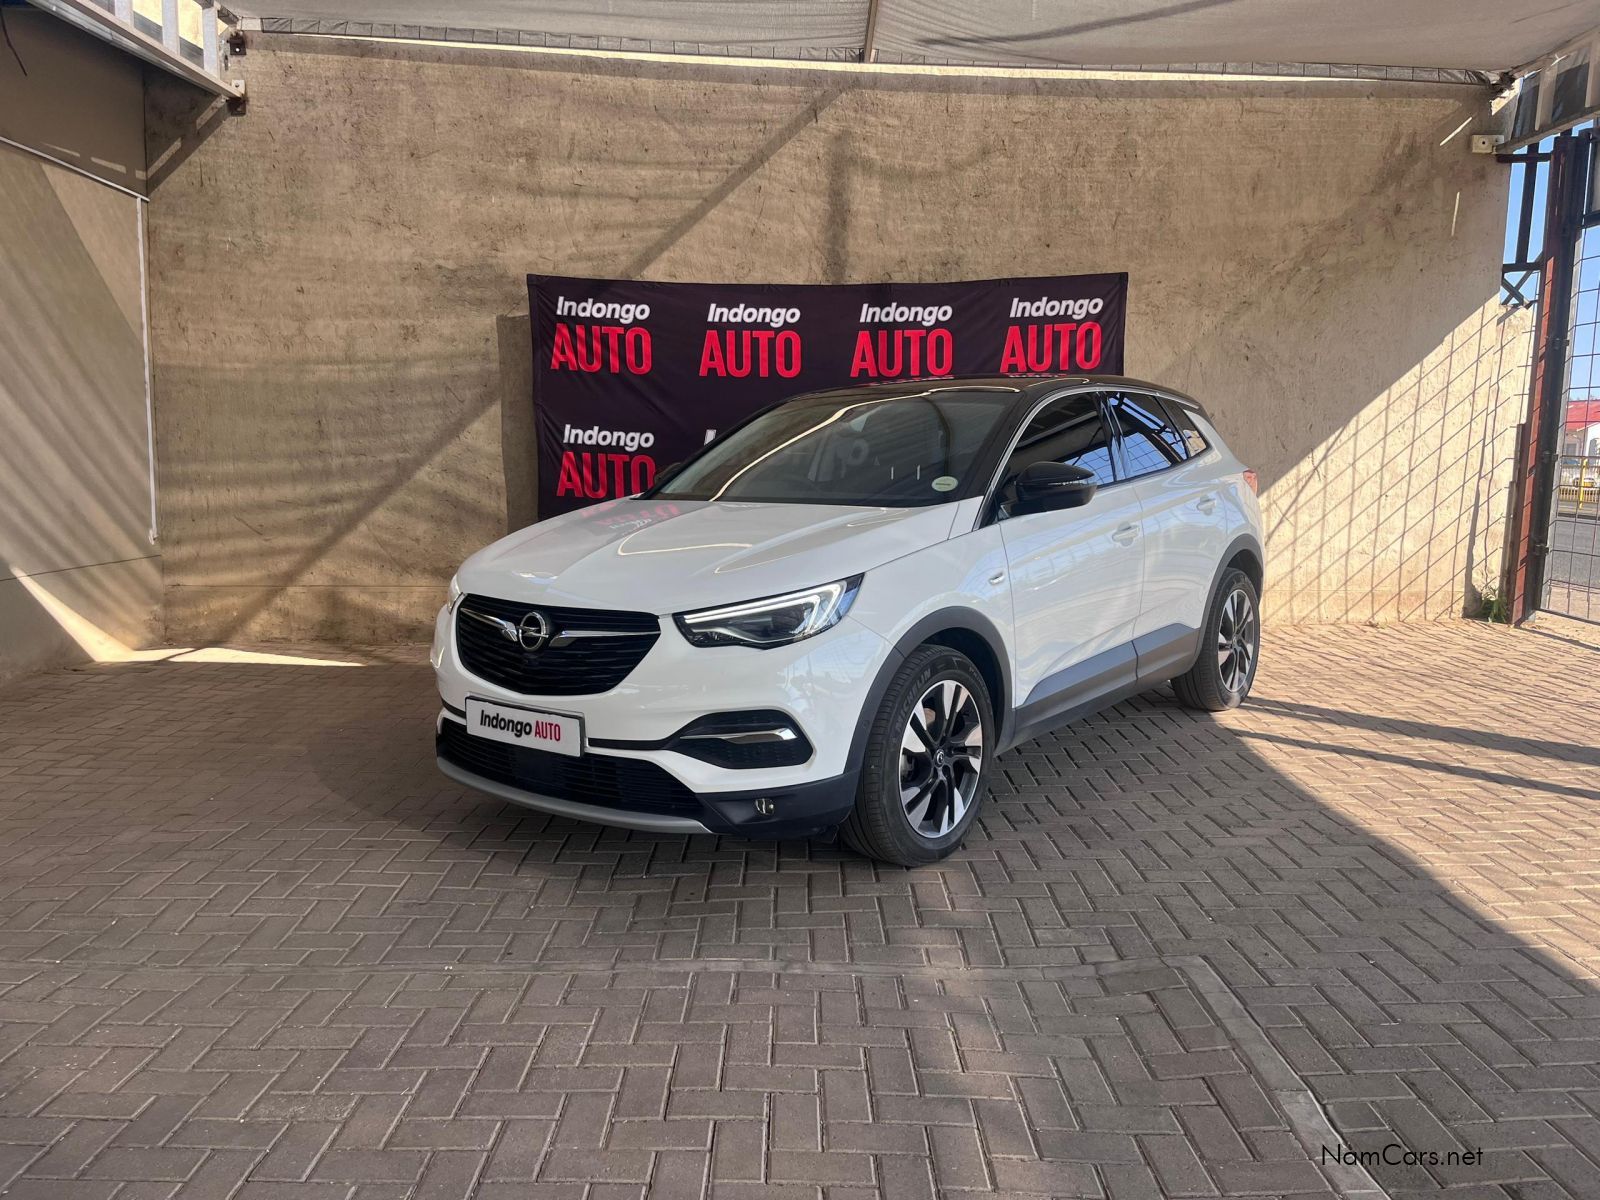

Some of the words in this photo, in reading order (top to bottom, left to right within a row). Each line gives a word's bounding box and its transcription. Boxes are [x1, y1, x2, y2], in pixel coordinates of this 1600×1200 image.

[556, 296, 651, 325] Indongo
[707, 302, 801, 328] Indongo
[859, 302, 953, 327] Indongo
[1009, 297, 1104, 320] Indongo
[551, 325, 652, 374] AUTO
[699, 330, 801, 377] AUTO
[850, 329, 953, 377] AUTO
[1000, 321, 1102, 373] AUTO
[562, 424, 655, 452] Indongo
[556, 451, 657, 499] AUTO
[480, 709, 533, 738] Indongo
[534, 720, 561, 742] AUTO
